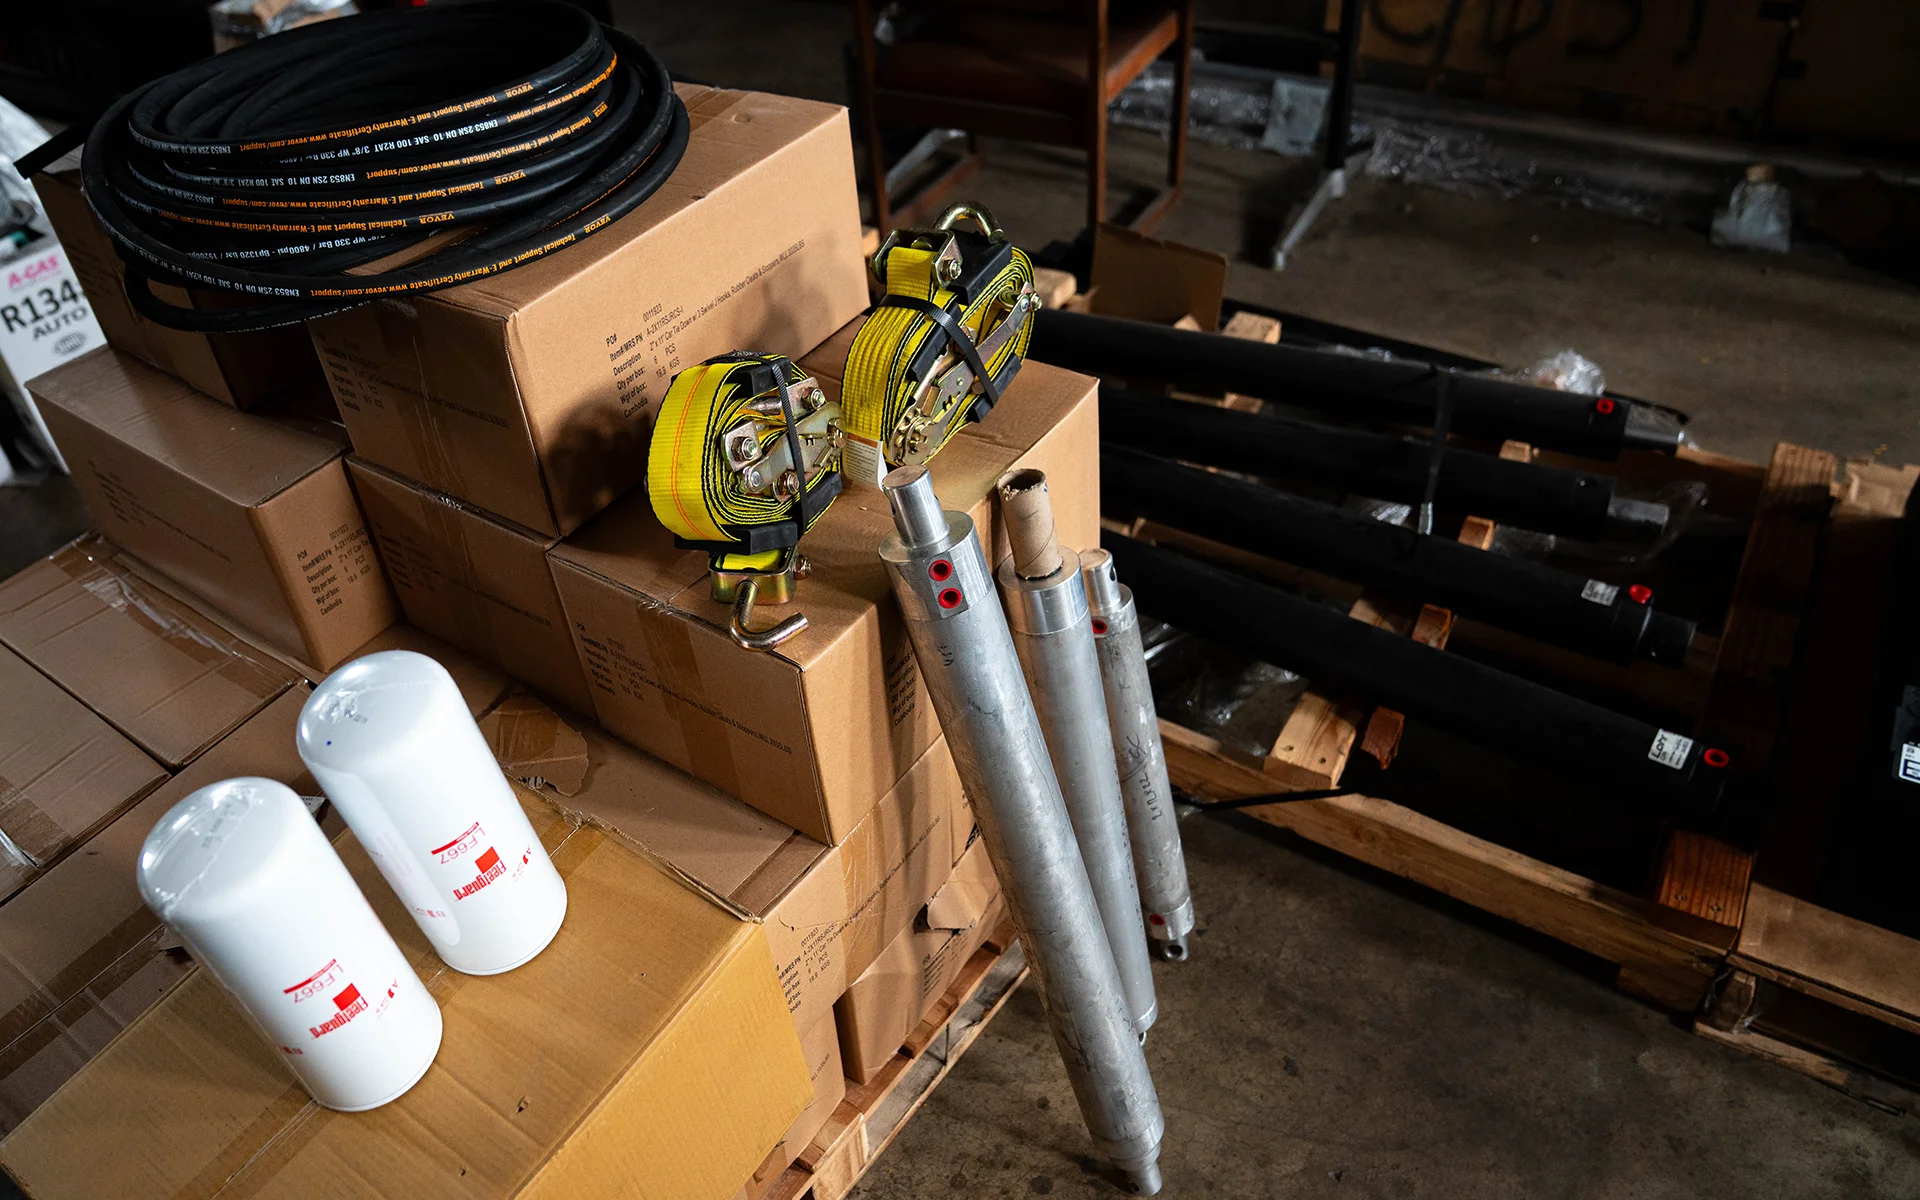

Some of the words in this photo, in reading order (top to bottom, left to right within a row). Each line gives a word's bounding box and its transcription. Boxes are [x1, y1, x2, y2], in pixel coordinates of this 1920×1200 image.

[504, 82, 532, 97] VEVOR
[463, 93, 496, 110] Technical
[416, 111, 431, 122] and
[432, 103, 463, 118] Support
[372, 116, 415, 131] E-Warranty
[474, 120, 498, 133] EN853
[328, 125, 371, 139] Certificate
[433, 133, 443, 141] 10
[445, 130, 456, 140] DN
[458, 126, 473, 137] 2SN
[239, 132, 326, 151] www.vevor.com/support
[374, 142, 394, 151] R2AT
[396, 139, 412, 148] 100
[414, 136, 429, 145] SAE
[337, 148, 349, 158] WP
[501, 141, 536, 155] E-Warranty
[461, 150, 500, 164] Certificate
[366, 158, 460, 178] www.vevor.com/support
[288, 177, 296, 185] 10
[299, 176, 309, 184] DN
[312, 175, 327, 183] 2SN
[330, 174, 354, 182] EN853
[493, 169, 525, 183] VEVOR
[448, 180, 483, 195] Technical
[352, 195, 396, 207] E-Warranty
[399, 194, 412, 202] and
[414, 188, 446, 201] Support
[222, 198, 306, 207] www.vevor.com/support
[309, 200, 350, 208] Certificate
[419, 210, 454, 225] VEVOR
[582, 213, 610, 233] VEVOR
[231, 222, 270, 231] Certificate
[272, 222, 314, 231] E-Warranty
[334, 222, 365, 231] Support
[369, 219, 407, 230] Technical
[318, 241, 332, 249] Bar
[334, 237, 350, 247] 330
[352, 236, 365, 245] WP
[544, 233, 575, 251] Technical
[277, 243, 310, 255] 4800psi
[513, 246, 543, 264] Support
[498, 258, 513, 269] and
[454, 264, 497, 282] E-Warranty
[216, 278, 230, 288] SAE
[257, 285, 271, 294] 2SN
[409, 276, 453, 290] Certificate
[274, 288, 298, 296] EN853
[310, 284, 407, 296] www.vevor.com/support
[0, 279, 84, 334] R134
[32, 307, 88, 341] AUTO
[606, 332, 617, 347] PO#
[642, 303, 662, 323] 0011923
[613, 351, 641, 376] Description
[664, 328, 673, 340] Car
[679, 315, 692, 329] Down
[696, 309, 701, 318] 3
[700, 300, 713, 316] Swivel
[730, 278, 746, 295] Rubber
[745, 270, 758, 285] Cleats
[758, 268, 762, 277] &
[635, 332, 643, 344] PN
[616, 378, 626, 391] Qty
[626, 374, 634, 385] per
[633, 366, 645, 378] box:
[653, 355, 657, 365] 6
[665, 342, 675, 356] PCS
[620, 391, 630, 405] Wgt
[630, 387, 636, 397] of
[635, 381, 646, 393] box:
[656, 365, 666, 379] 19.9
[668, 356, 679, 370] KGS
[623, 396, 647, 418] Cambodia
[306, 562, 332, 583] Description
[320, 598, 342, 615] Cambodia
[440, 827, 486, 865] LF667
[453, 859, 507, 901] Fleetguard
[818, 951, 827, 963] PCS
[820, 959, 829, 972] KGS
[293, 963, 344, 1004] LF667
[309, 995, 369, 1039] Fleetguard
